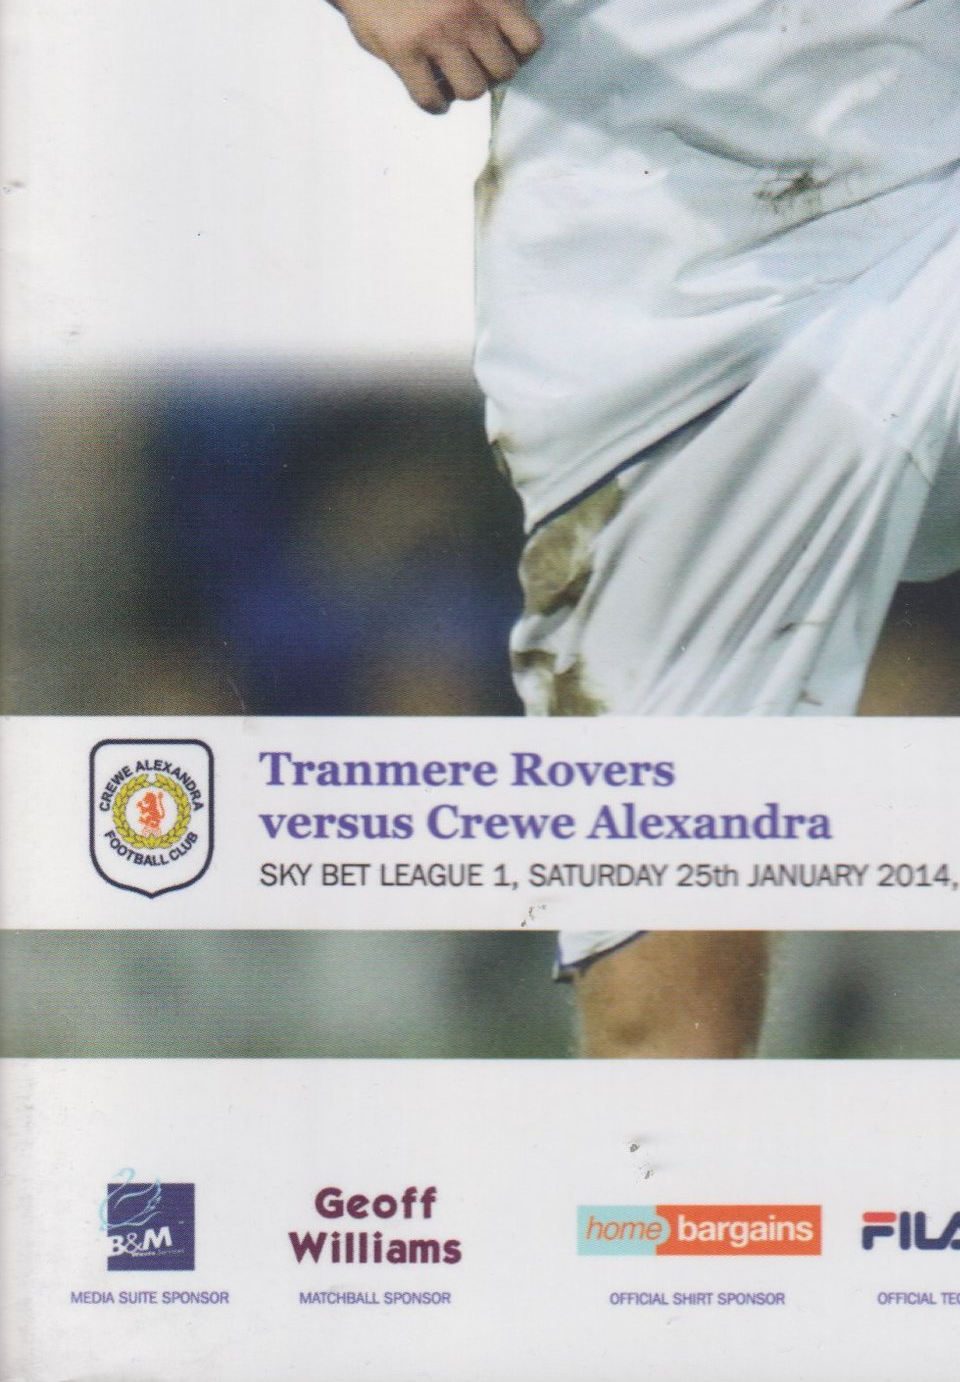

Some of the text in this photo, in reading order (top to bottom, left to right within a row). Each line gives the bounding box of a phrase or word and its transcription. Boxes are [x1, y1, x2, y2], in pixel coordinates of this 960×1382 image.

[98, 758, 205, 813] CREWE ALEXANDRA
[258, 750, 676, 788] Tranmere Rovers
[257, 801, 834, 842] versus Crewe Alexandra
[103, 829, 199, 867] FOOTBALL CLUB
[259, 862, 312, 888] SKY
[320, 862, 371, 888] BET
[379, 862, 484, 888] LEAGUE
[492, 862, 520, 892] 1,
[527, 862, 669, 888] SATURDAY
[675, 862, 739, 888] 25th
[746, 862, 869, 888] JANUARY
[876, 862, 960, 892] 2014,
[314, 1186, 438, 1220] Geoff
[107, 1226, 173, 1256] B&M
[288, 1230, 463, 1265] Williams
[585, 1214, 814, 1249] home bargains
[70, 1291, 230, 1305] MEDIA SUITE SPONSOR
[299, 1291, 452, 1305] MATCHBALL SPONSOR
[609, 1292, 786, 1305] OFFICIAL SHIRT SPONSOR
[877, 1292, 938, 1305] OFFICIAL
